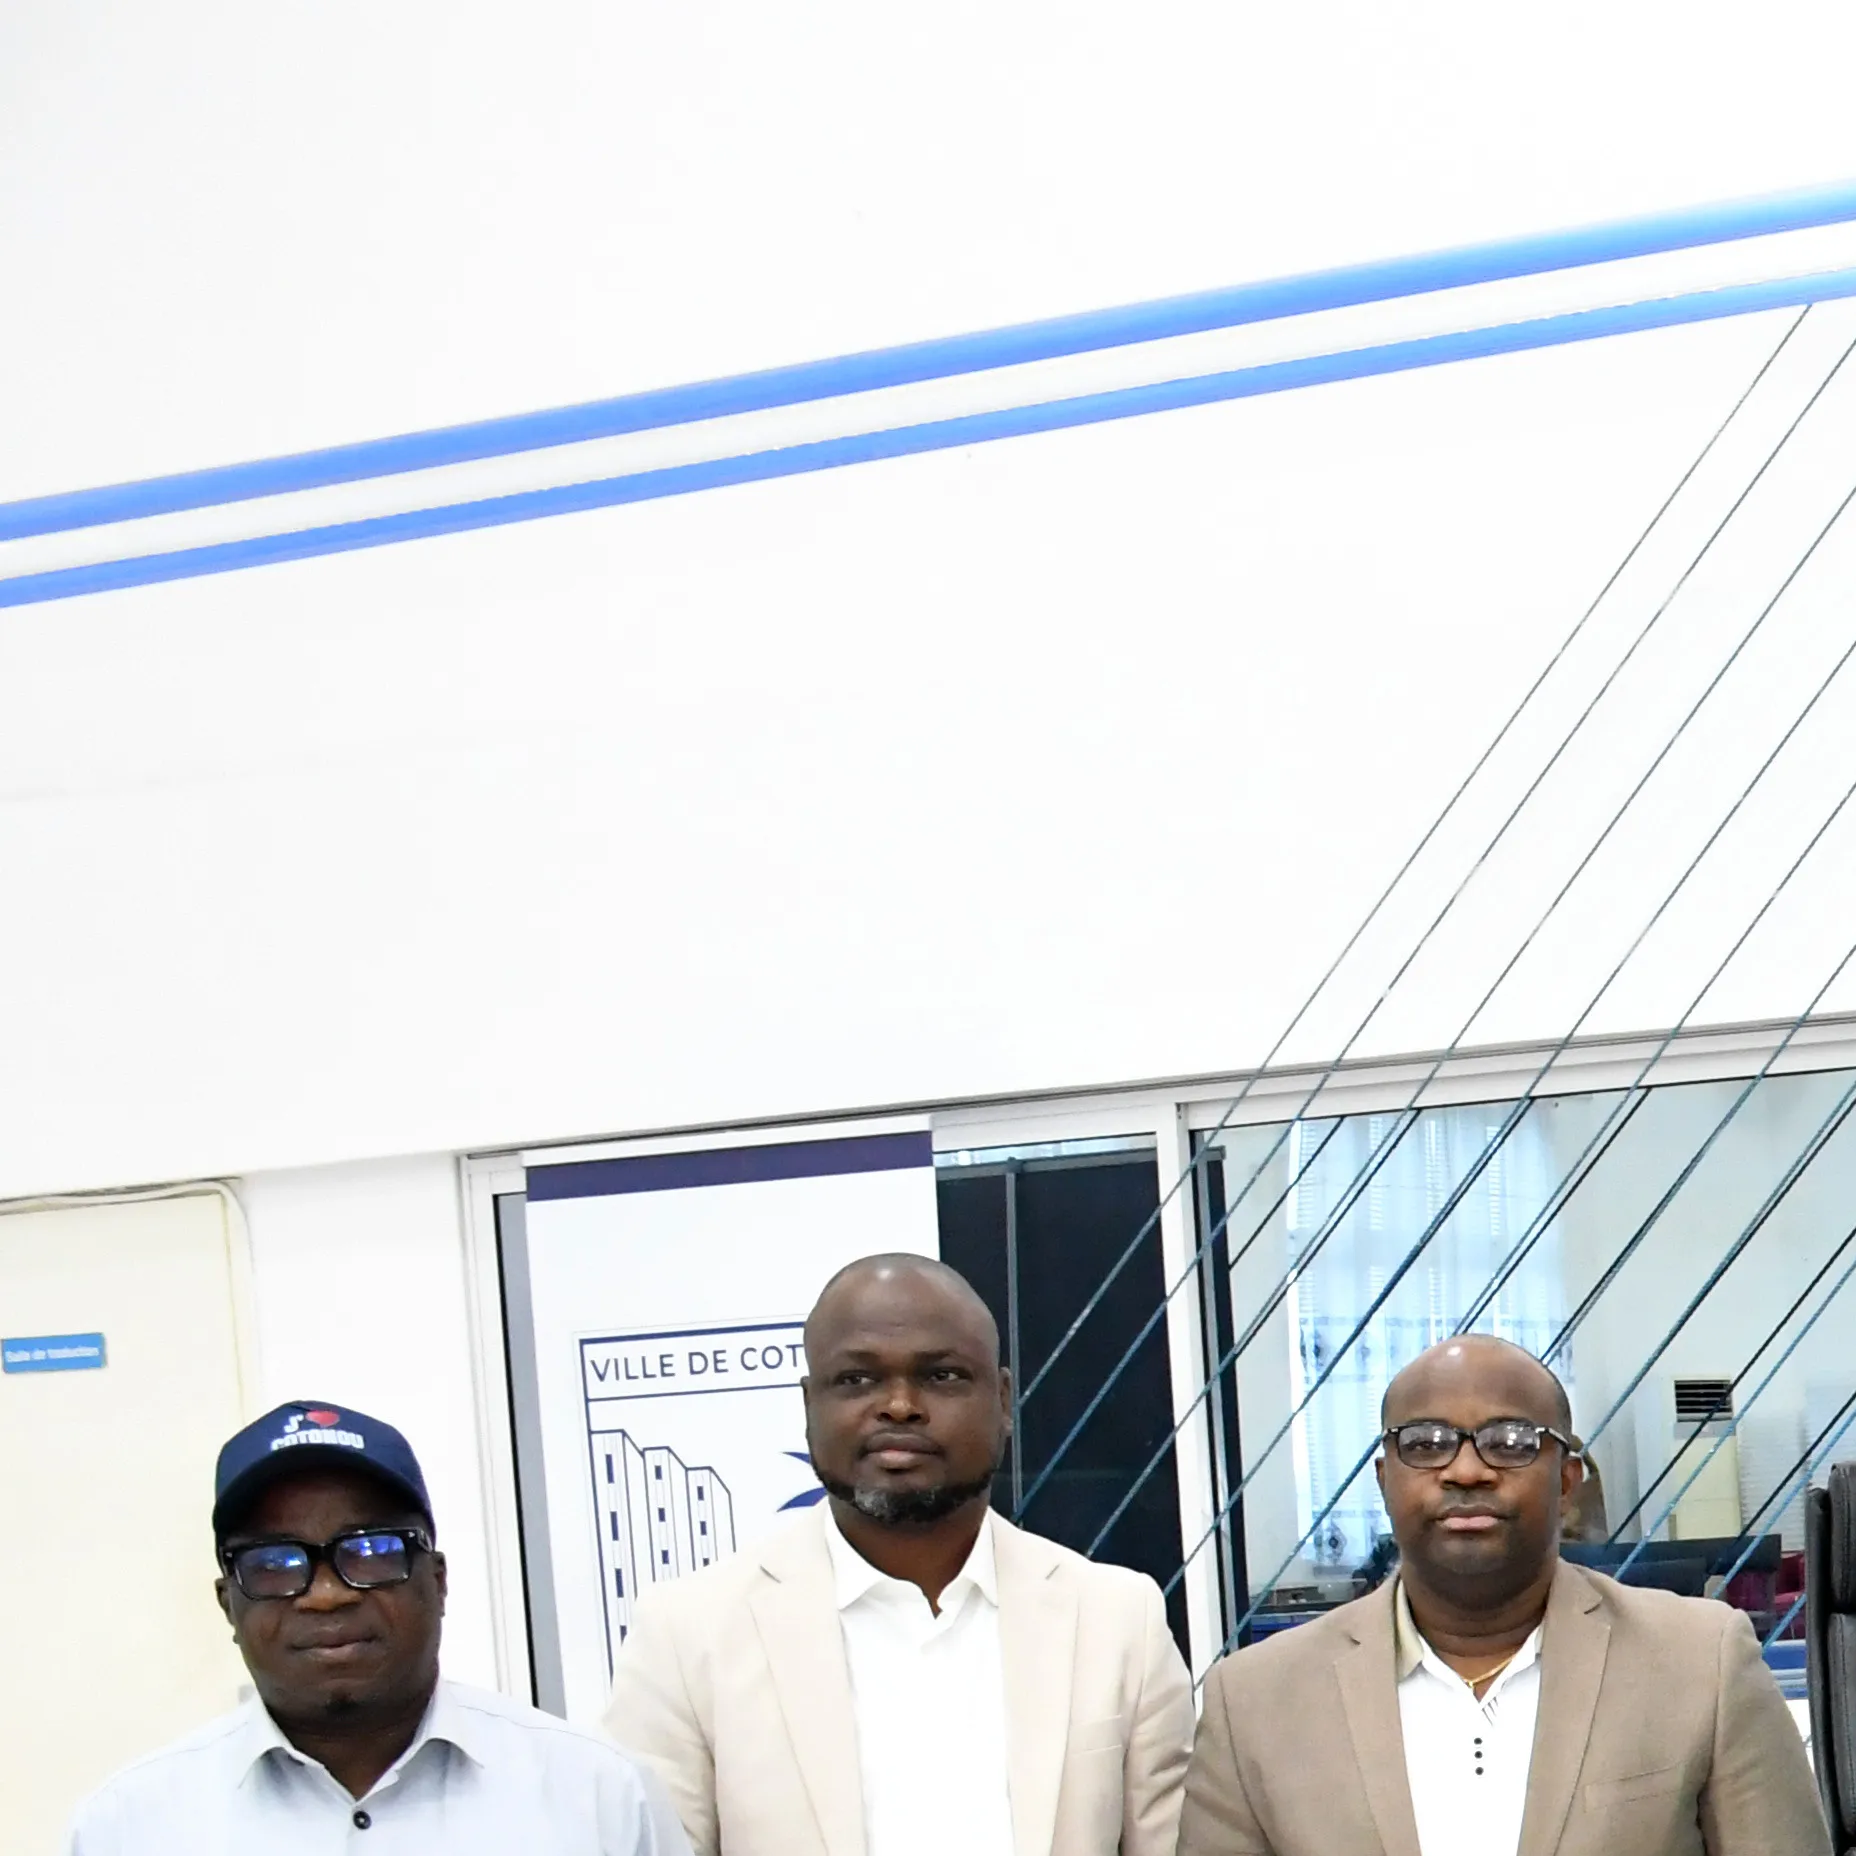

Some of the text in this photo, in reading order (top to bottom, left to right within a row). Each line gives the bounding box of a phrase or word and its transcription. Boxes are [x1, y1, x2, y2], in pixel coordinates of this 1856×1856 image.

[590, 1344, 804, 1382] VILLE DE COT
